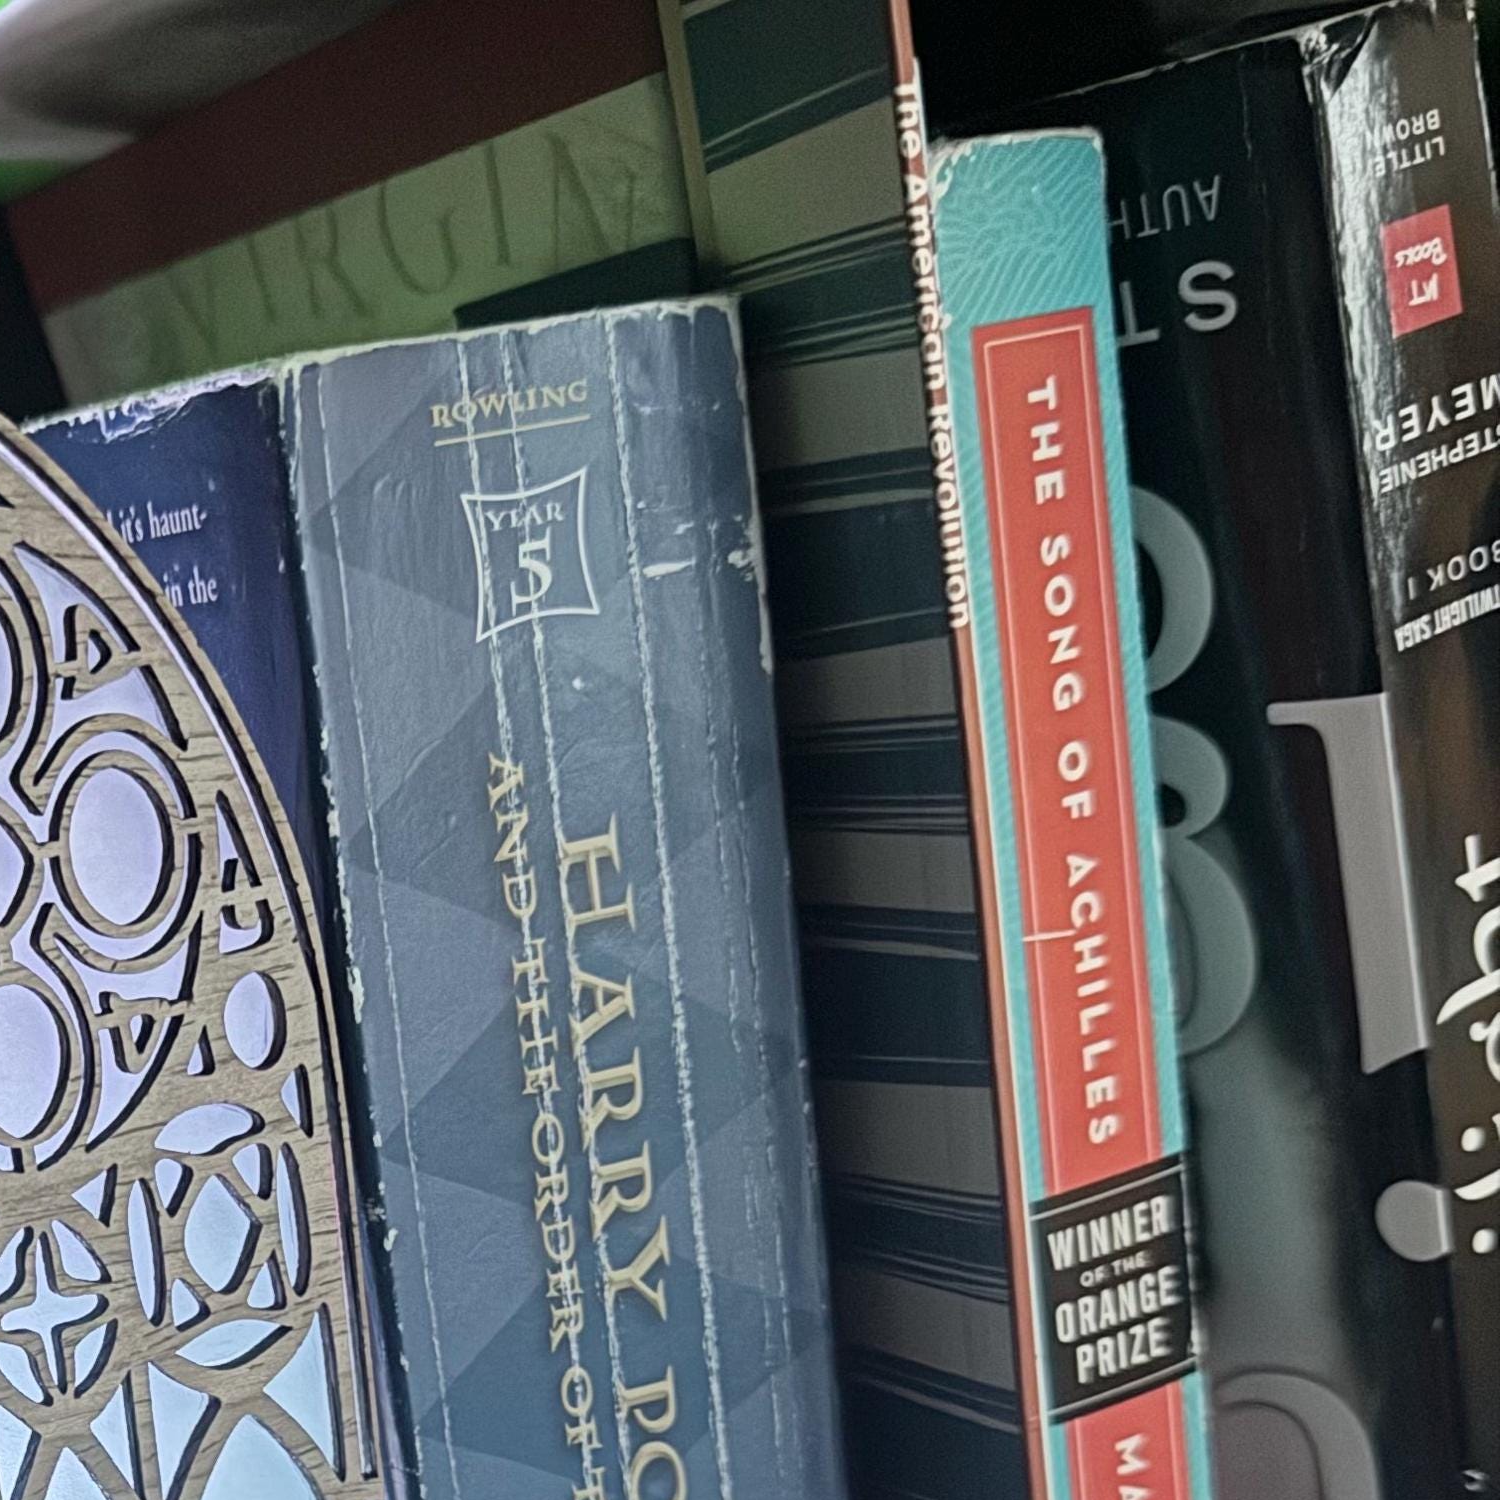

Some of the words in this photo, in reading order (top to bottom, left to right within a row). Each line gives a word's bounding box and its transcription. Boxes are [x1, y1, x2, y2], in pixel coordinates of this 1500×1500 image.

[1375, 136, 1446, 178] LITTLE
[431, 377, 589, 429] ROWLING
[904, 174, 947, 391] American
[927, 403, 971, 630] Revolution
[1027, 374, 1067, 504] THE
[147, 500, 208, 540] haunt-
[484, 501, 565, 532] YEAR
[187, 564, 219, 605] the
[510, 539, 556, 615] 5
[1038, 534, 1085, 712] SONG
[1057, 740, 1095, 820] OF
[487, 751, 538, 920] AND
[512, 938, 561, 1097] THE
[1066, 853, 1124, 1147] ACHILLES
[560, 811, 669, 1322] HARRY
[530, 1111, 586, 1354] ORDER
[1047, 1195, 1174, 1271] WINNER
[1079, 1264, 1108, 1288] OF
[1110, 1250, 1151, 1276] THE
[1055, 1265, 1182, 1343] ORANGE
[1076, 1316, 1171, 1385] PRIZE
[560, 1364, 603, 1448] OF
